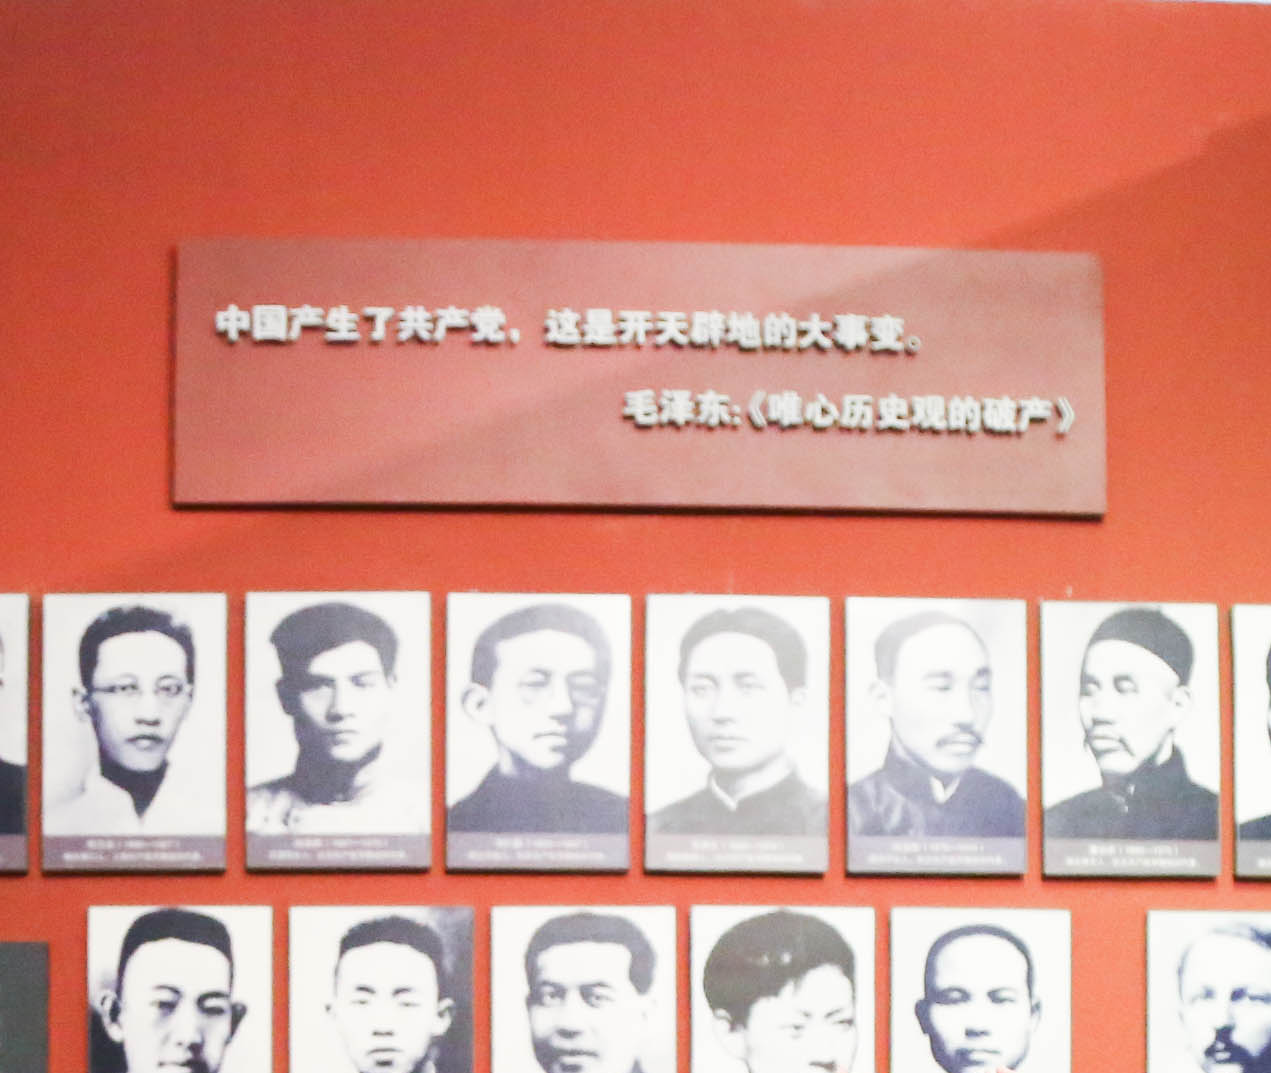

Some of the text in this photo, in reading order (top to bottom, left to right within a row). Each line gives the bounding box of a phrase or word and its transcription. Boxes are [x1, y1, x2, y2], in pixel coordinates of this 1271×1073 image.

[215, 303, 922, 353] 中国产生了共产党，这是开天辟地的大事变。
